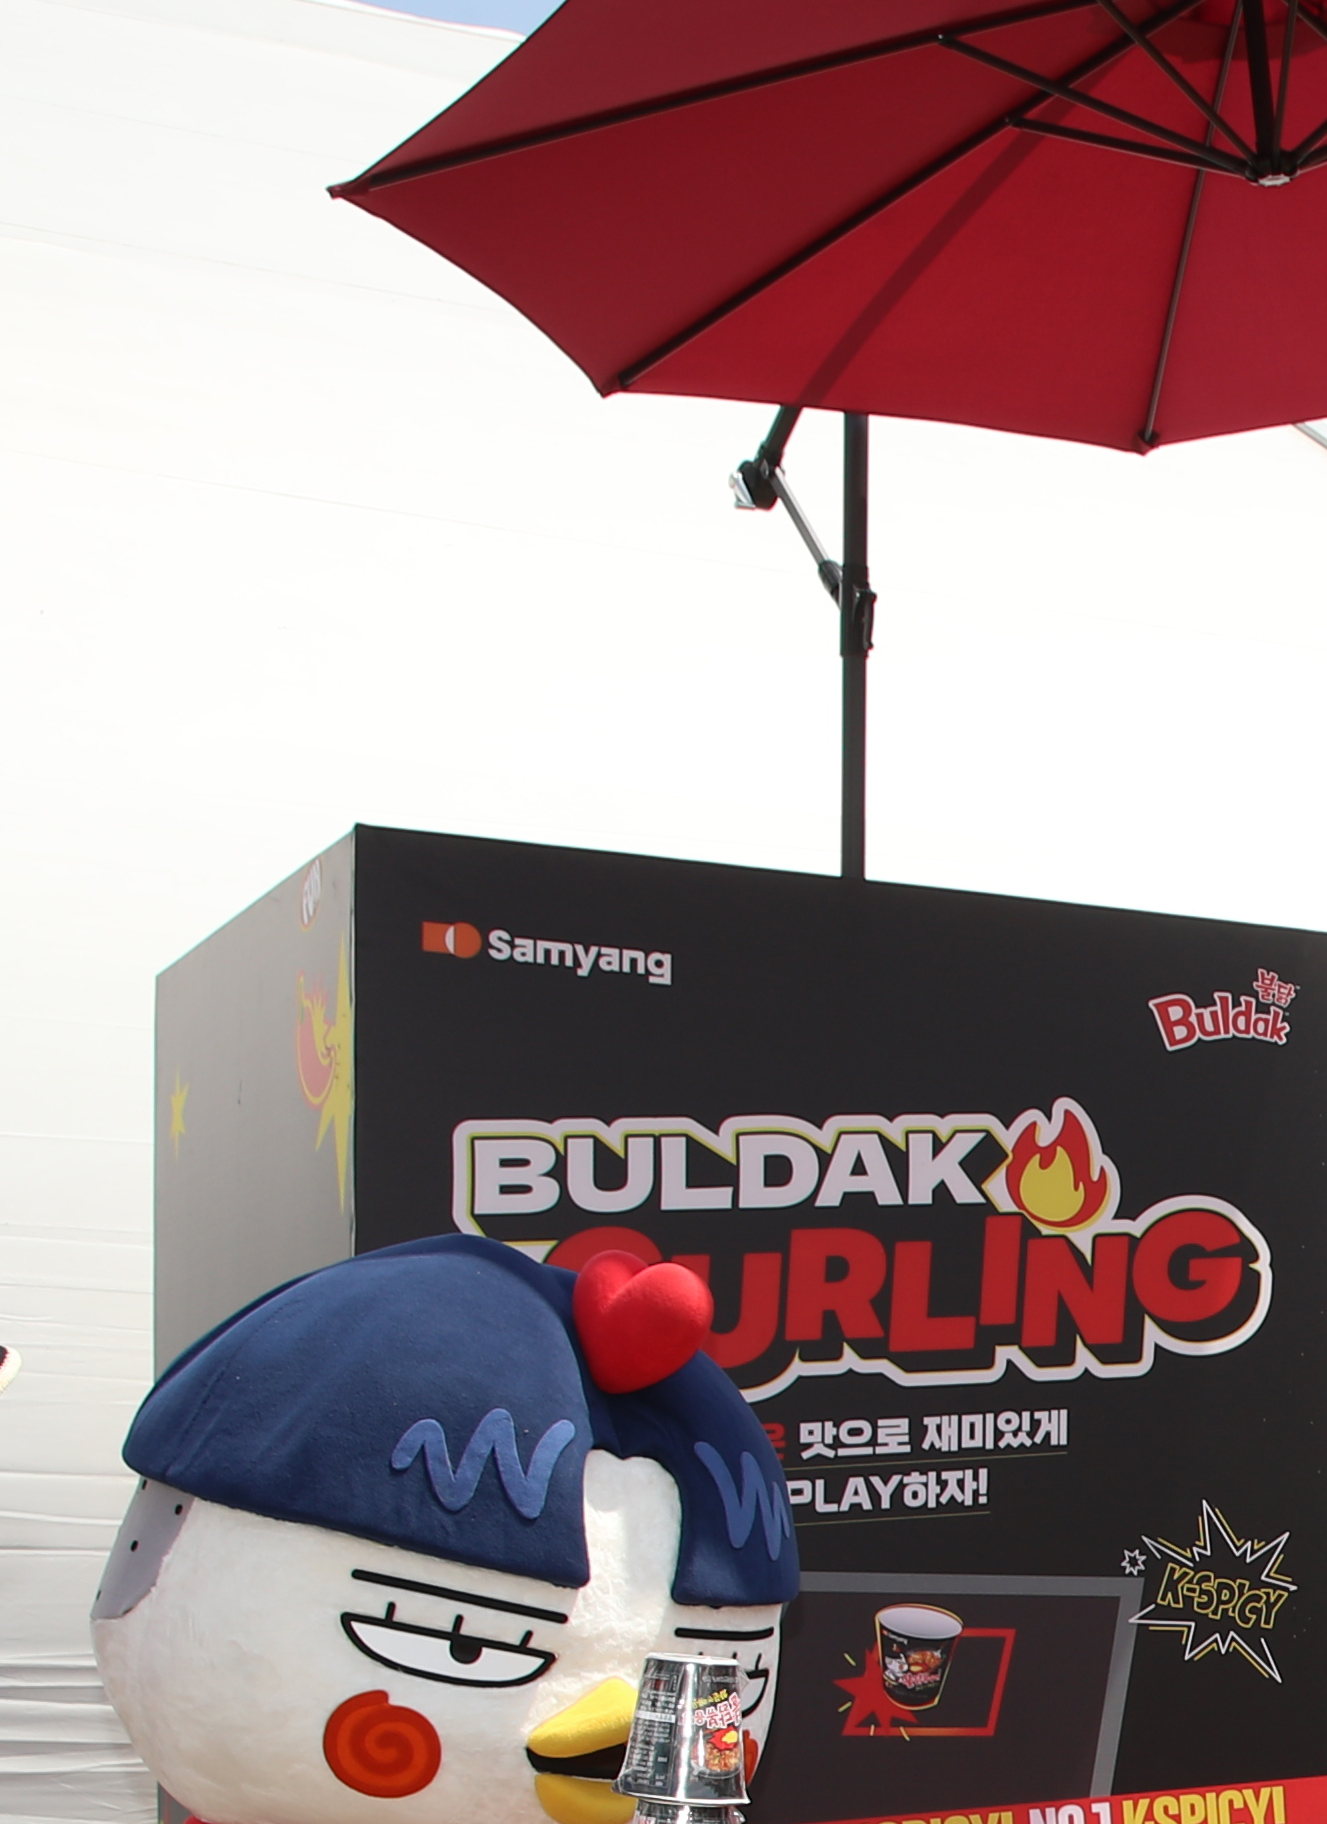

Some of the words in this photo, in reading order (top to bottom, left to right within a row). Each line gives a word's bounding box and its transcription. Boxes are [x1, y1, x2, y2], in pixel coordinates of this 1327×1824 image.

[487, 928, 673, 986] Samyang
[1253, 968, 1296, 1006] 불닭
[1148, 992, 1290, 1051] Buldak
[472, 1130, 988, 1215] BULDAK
[543, 1209, 1244, 1371] URLING
[799, 1417, 912, 1460] 맛으로
[921, 1408, 1069, 1452] 재미있게
[1156, 1562, 1289, 1629] K-SPICY
